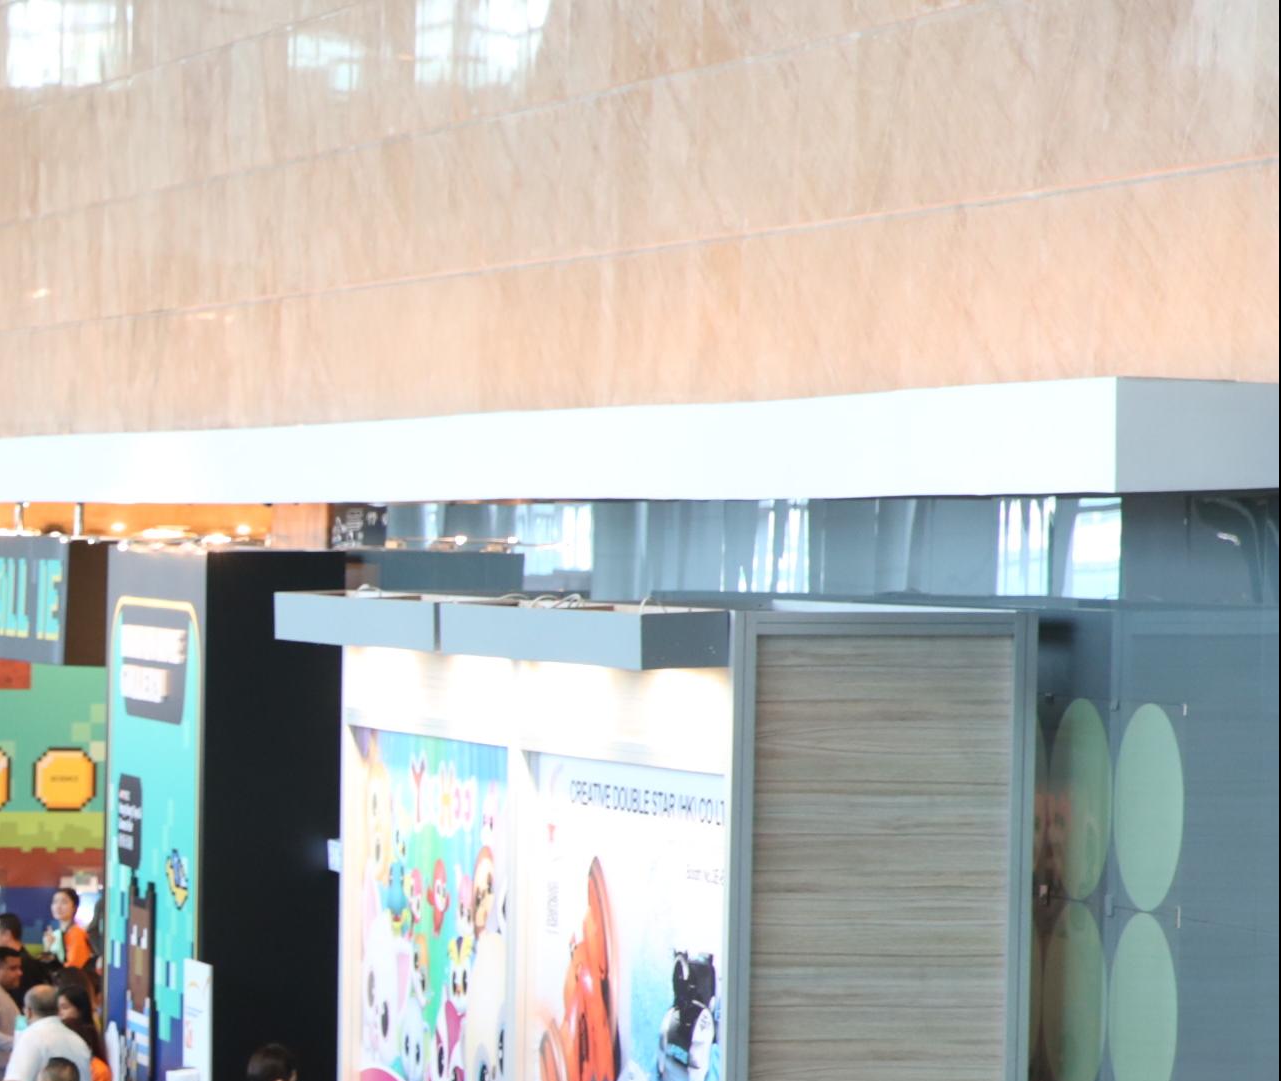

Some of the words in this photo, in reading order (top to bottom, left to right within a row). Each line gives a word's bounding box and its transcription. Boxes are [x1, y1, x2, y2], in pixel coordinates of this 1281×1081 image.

[571, 780, 609, 810] CREATIVE
[611, 786, 651, 816] DOUBLE
[652, 792, 675, 819] STAR
